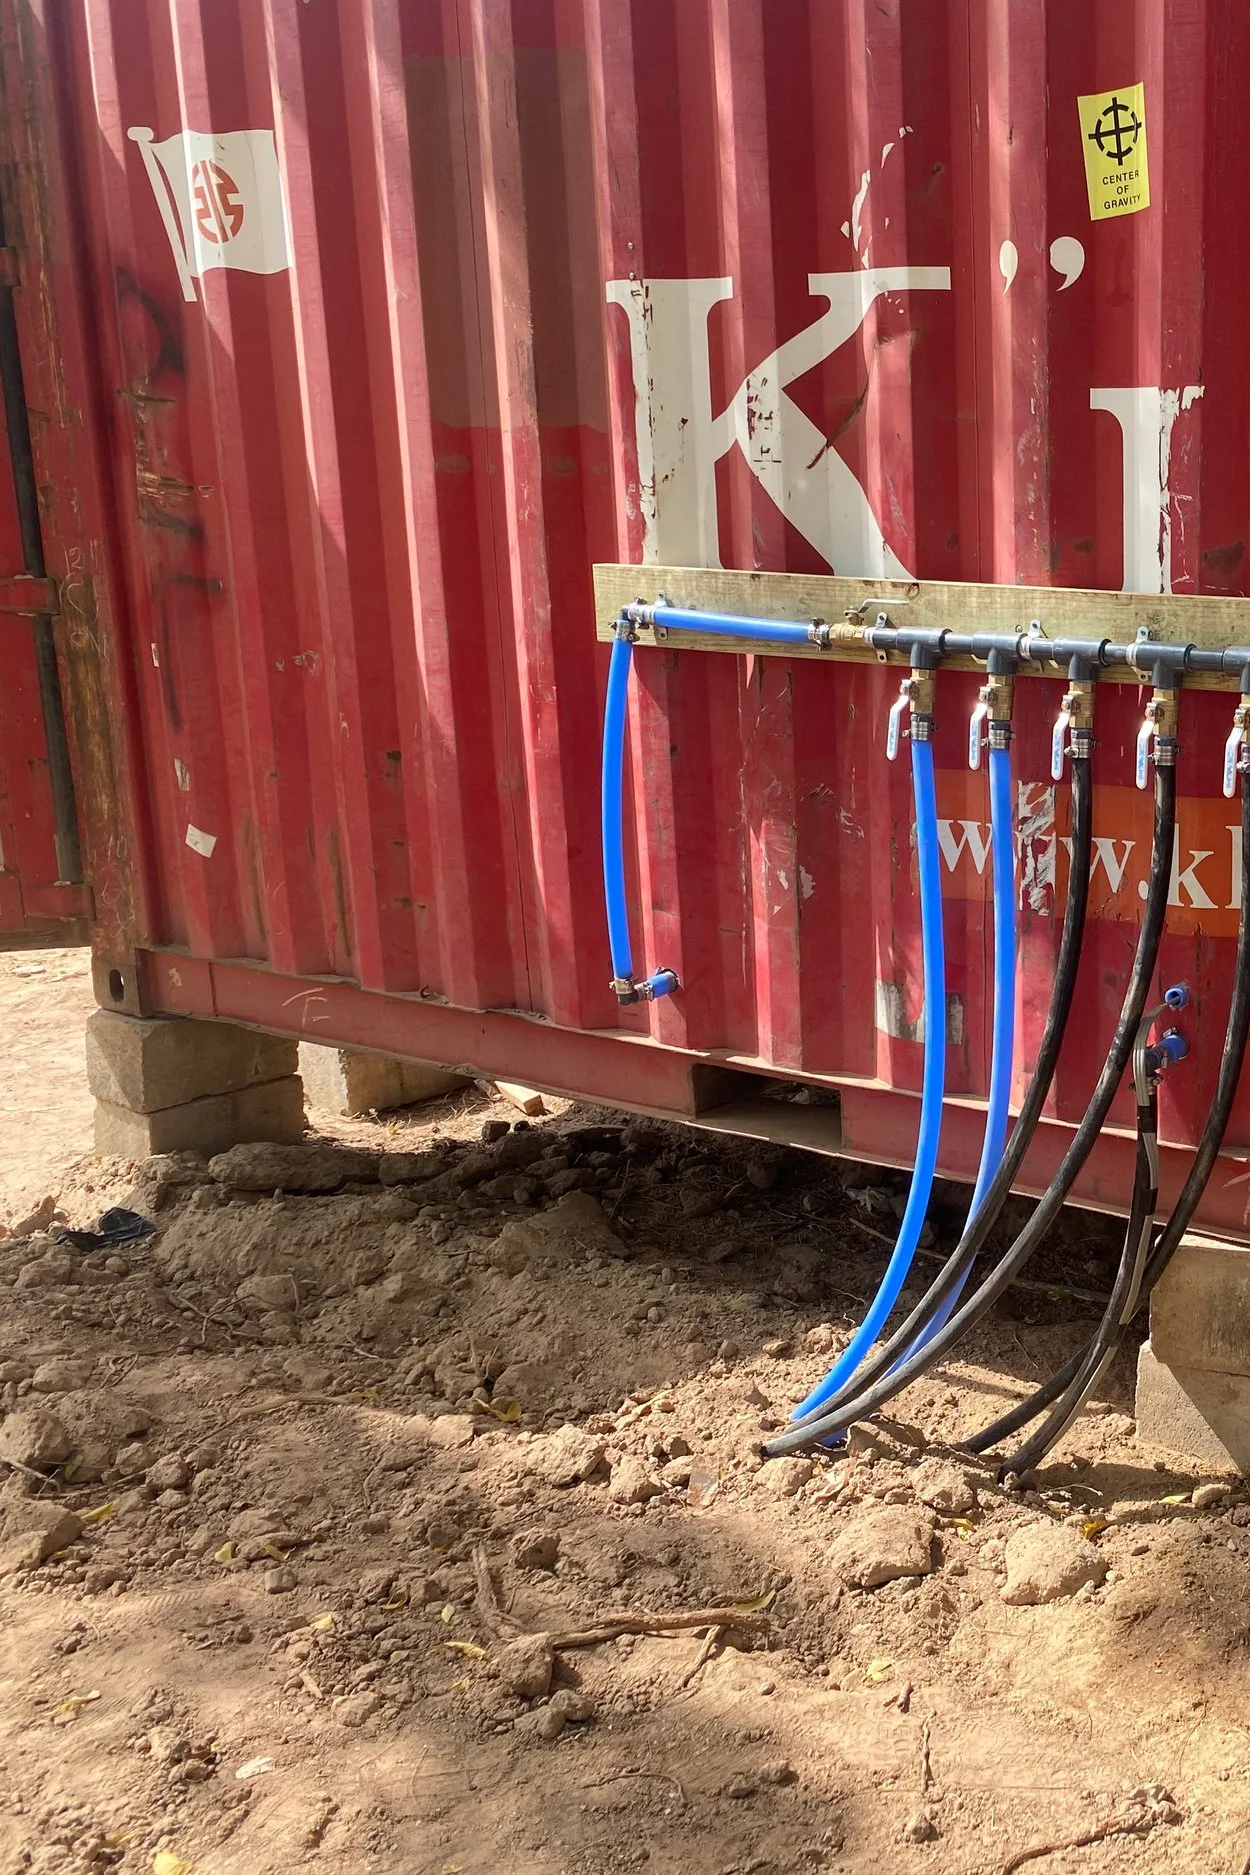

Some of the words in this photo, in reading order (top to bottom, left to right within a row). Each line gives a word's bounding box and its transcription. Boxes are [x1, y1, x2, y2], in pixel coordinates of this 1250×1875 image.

[1102, 170, 1140, 185] CENTER
[1116, 185, 1129, 195] OF
[1103, 194, 1141, 210] GRAVITY
